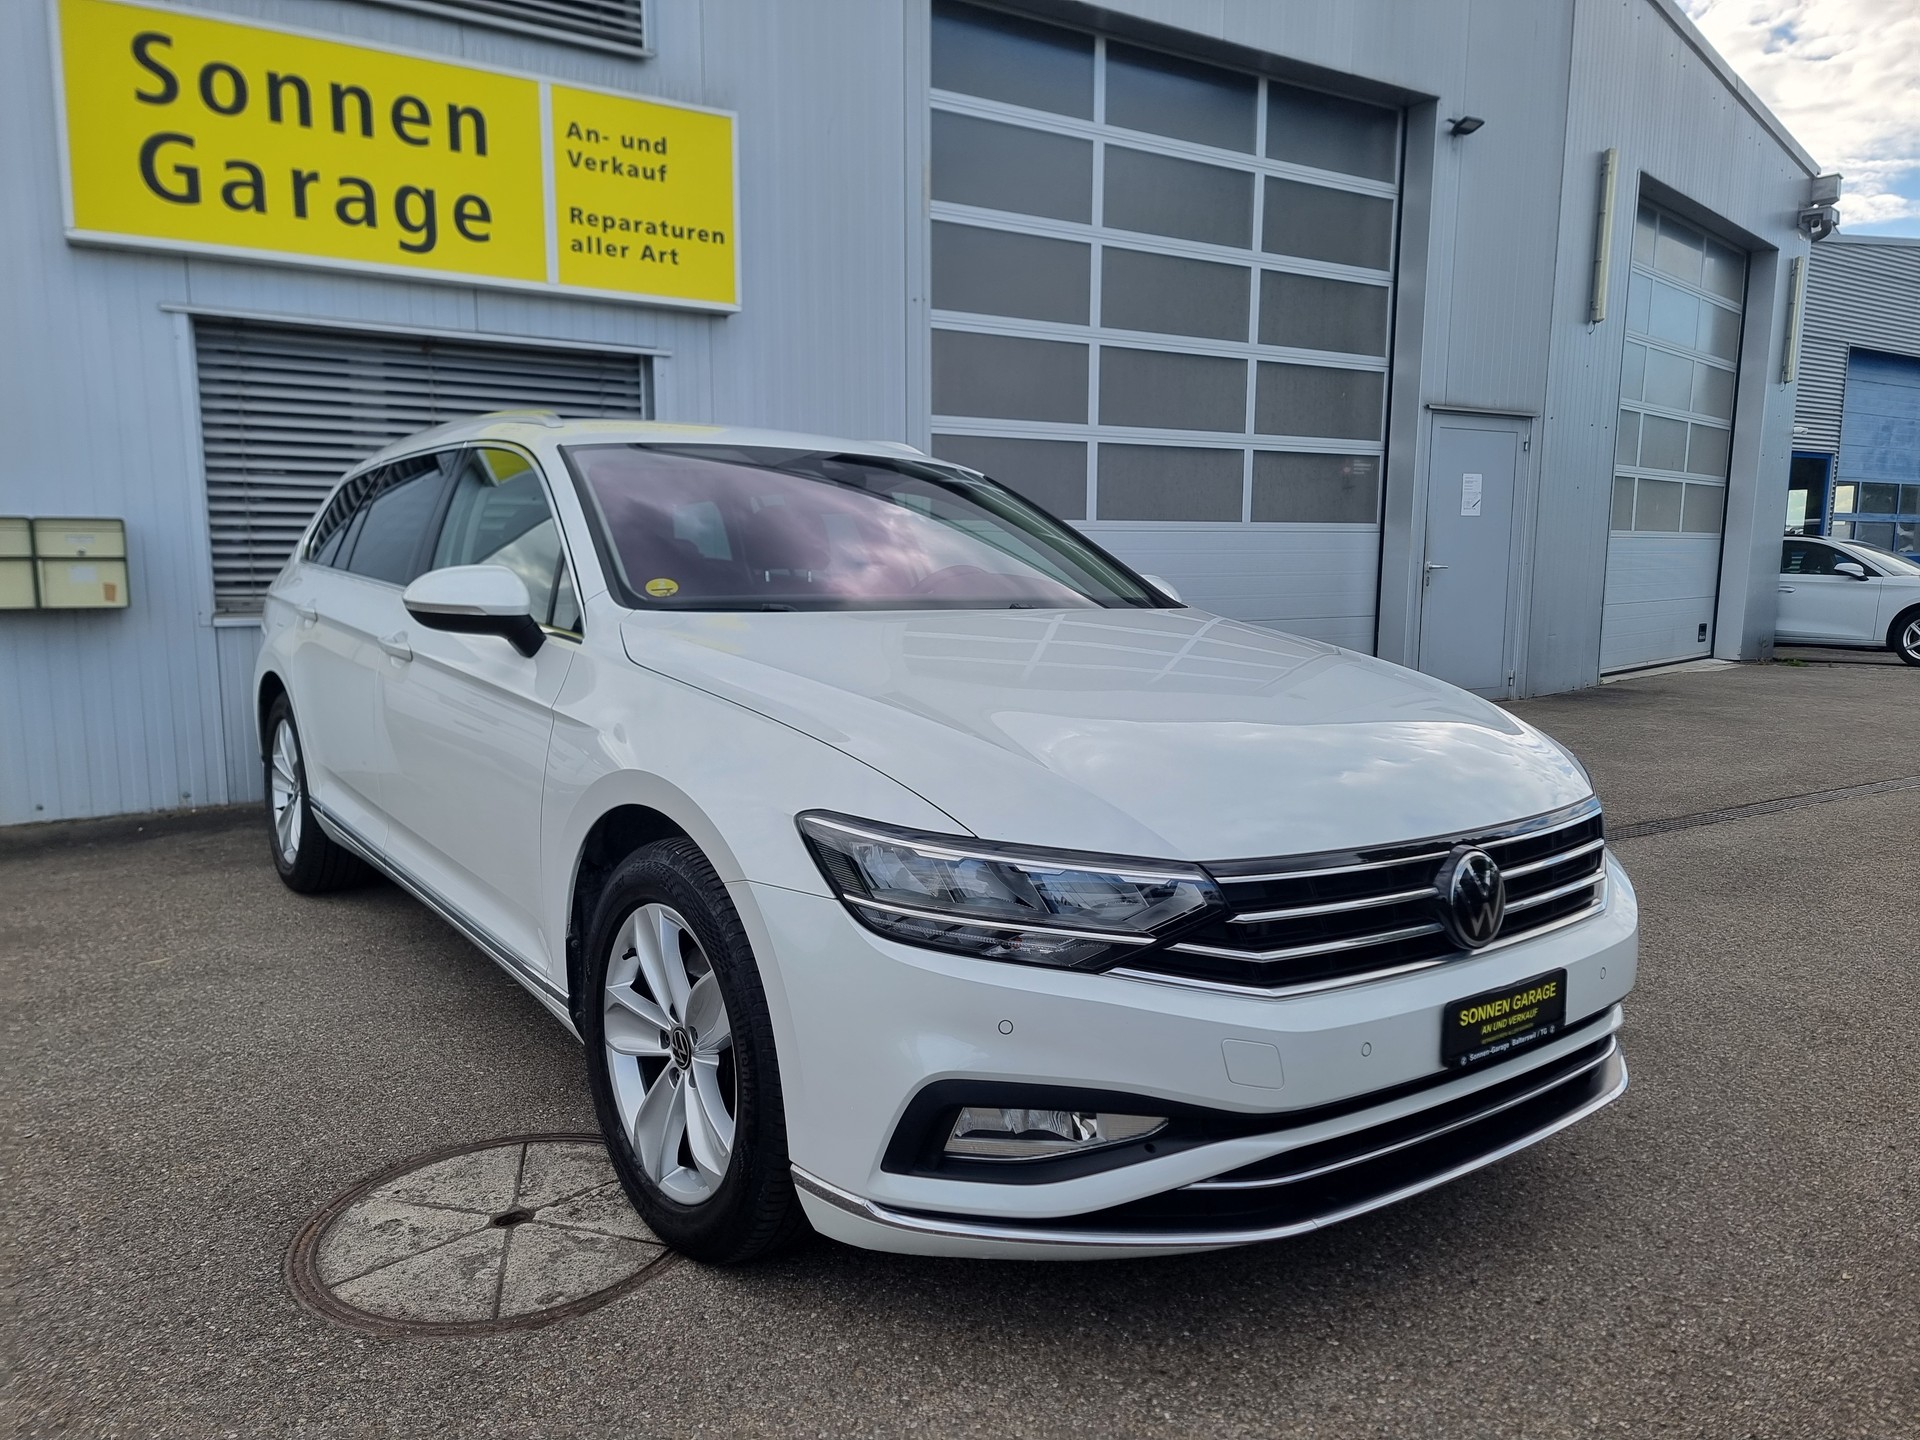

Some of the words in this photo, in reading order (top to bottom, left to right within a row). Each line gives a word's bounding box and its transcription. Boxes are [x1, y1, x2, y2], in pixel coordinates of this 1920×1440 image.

[130, 30, 489, 157] Sonnen
[566, 121, 610, 144] An-
[621, 136, 667, 155] und
[566, 149, 668, 183] Verkauf
[138, 131, 492, 254] Garage
[569, 206, 726, 245] Reparaturen
[570, 235, 629, 259] aller
[640, 244, 679, 265] Art
[1460, 998, 1510, 1027] SONNEN
[1512, 982, 1557, 1010] GARAGE
[1481, 1025, 1492, 1035] AN
[1493, 1019, 1507, 1031] UND
[1508, 1007, 1539, 1025] VERKAUF
[1469, 1042, 1510, 1061] Sonnen-Garage
